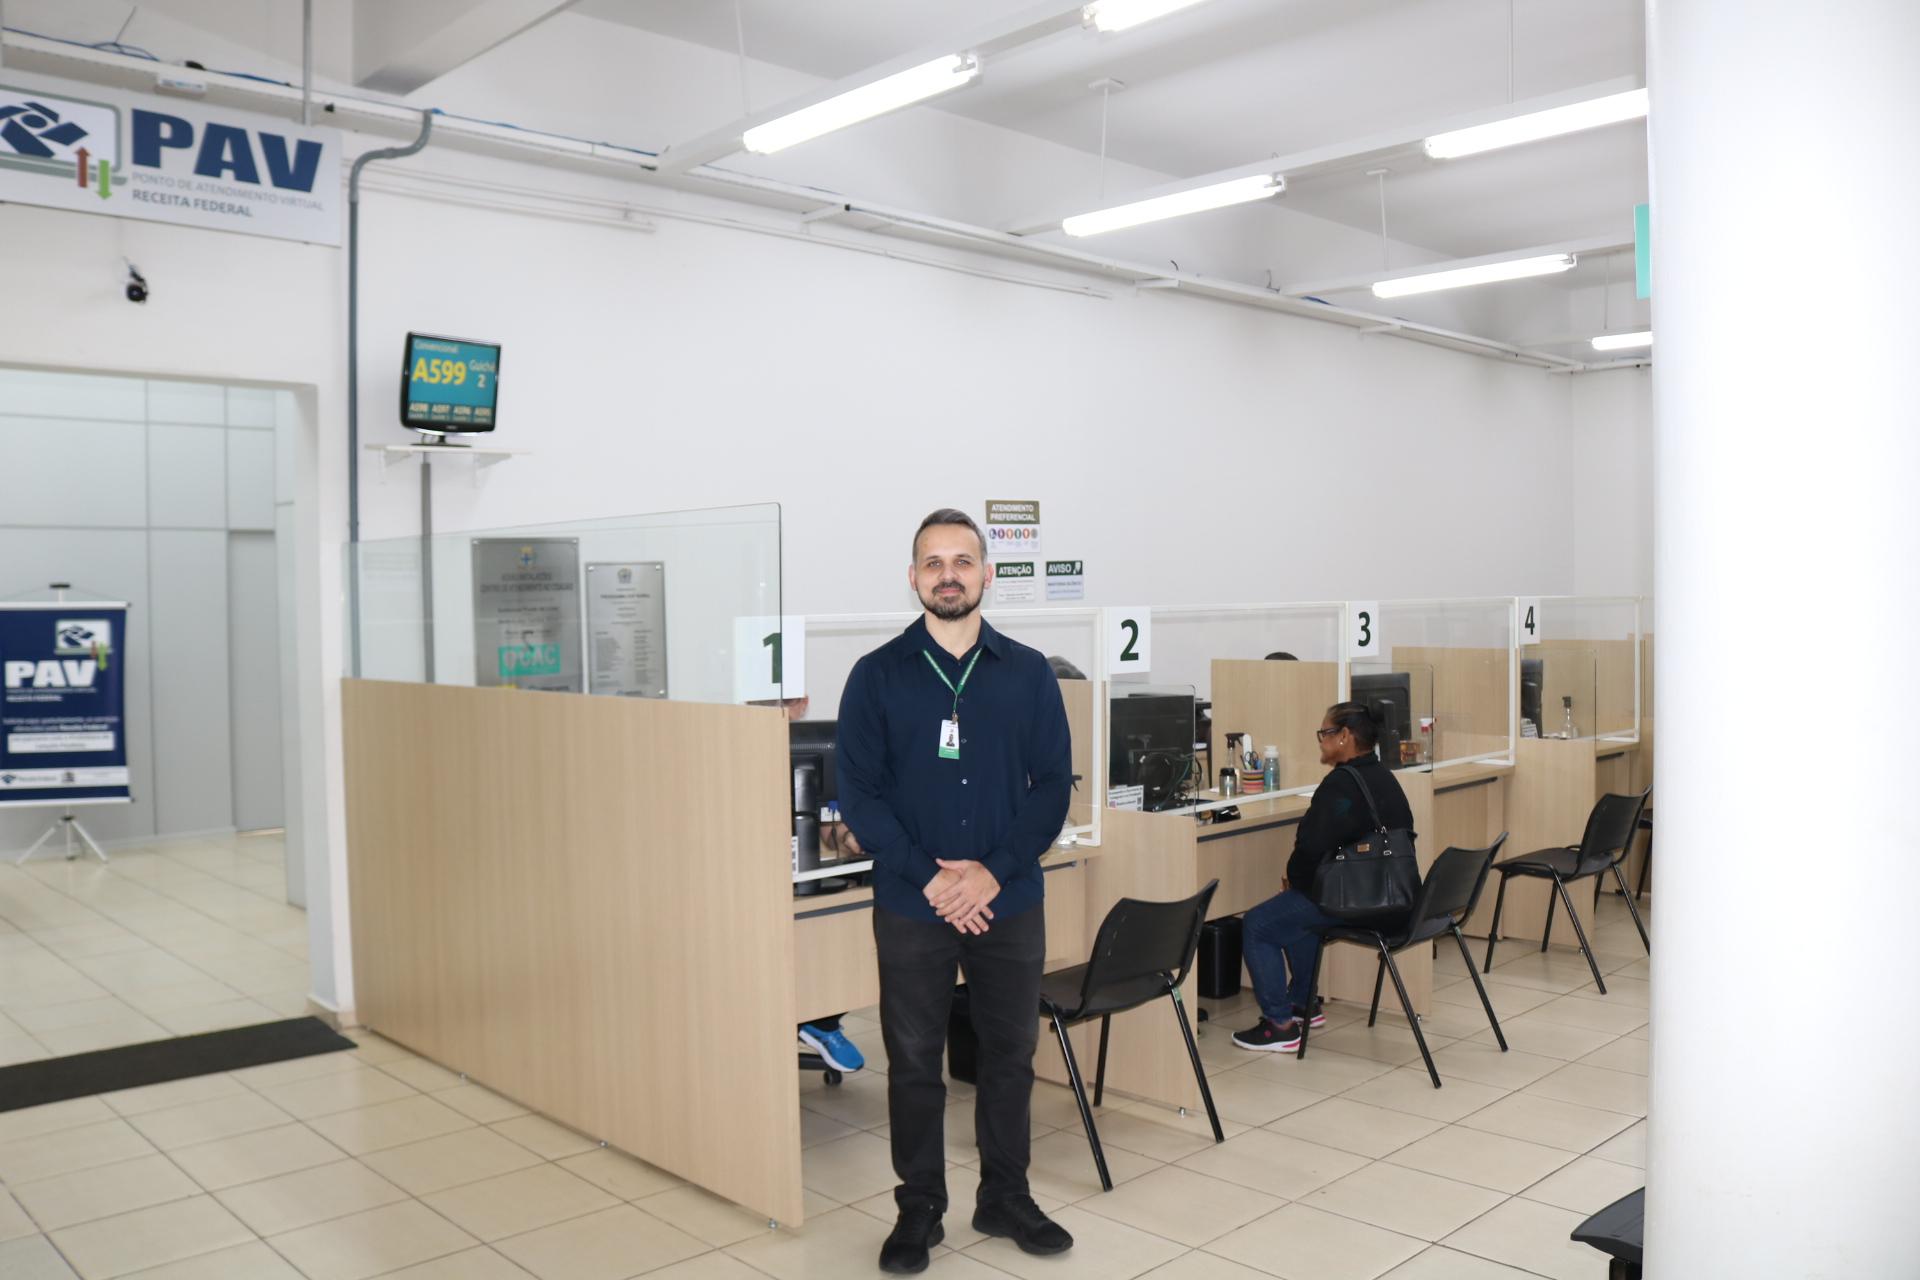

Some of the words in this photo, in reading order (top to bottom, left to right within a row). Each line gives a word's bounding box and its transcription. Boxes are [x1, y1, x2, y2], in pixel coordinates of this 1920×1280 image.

[131, 108, 323, 193] PAV
[132, 171, 175, 189] PONTO
[177, 179, 193, 190] DE
[195, 182, 280, 205] ATENDIMENTO
[279, 194, 324, 212] VIRTUAL
[132, 189, 190, 208] RECEITA
[193, 198, 253, 217] FEDERAL
[412, 357, 467, 385] A599
[477, 373, 486, 388] 2
[990, 513, 1036, 521] PREFERENCIAL
[991, 504, 1034, 512] ATENDIMENTO
[998, 564, 1032, 575] ATENÇÃO
[1048, 564, 1071, 574] AVISO
[1358, 611, 1371, 647] 3
[1525, 606, 1535, 635] 4
[1120, 619, 1139, 661] 2
[762, 632, 781, 684] 1
[5, 660, 97, 688] PAV
